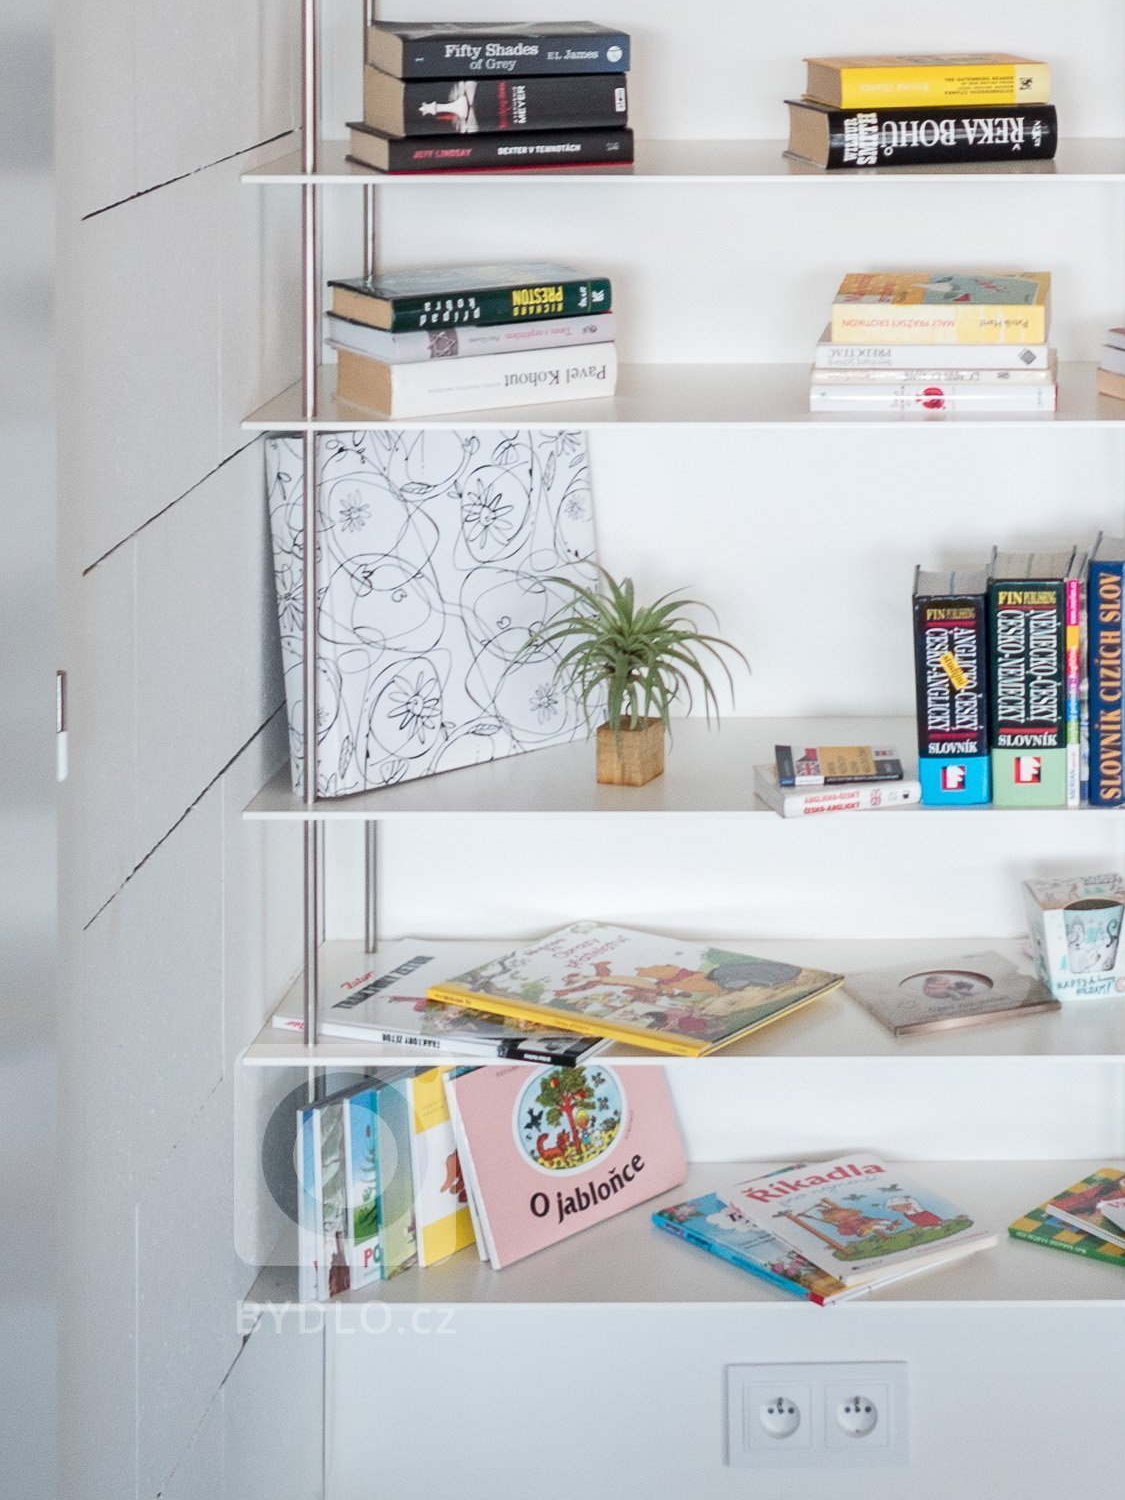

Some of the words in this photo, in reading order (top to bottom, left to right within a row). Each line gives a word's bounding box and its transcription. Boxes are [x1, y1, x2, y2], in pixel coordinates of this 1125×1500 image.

[444, 44, 483, 61] Fifty
[485, 42, 539, 58] Shades
[564, 49, 599, 61] James
[469, 58, 484, 71] of
[485, 58, 517, 71] Grey
[516, 85, 527, 124] MEYER
[843, 117, 859, 162] WILBUR
[856, 111, 879, 165] SMITH
[880, 117, 957, 157] BOHŮ
[961, 116, 1025, 151] ŘEKA
[423, 296, 476, 313] kobra
[511, 285, 564, 306] PRESTON
[512, 301, 563, 317] RICHARD
[503, 369, 562, 390] Kohout
[565, 364, 608, 386] Pavel
[998, 590, 1022, 605] FIN
[1098, 572, 1122, 623] SLOV
[925, 608, 945, 621] FIN
[1094, 629, 1122, 702] CIZÍCH
[928, 739, 978, 754] SLOVNÍK
[997, 732, 1057, 747] SLOVNÍK
[1093, 708, 1122, 800] SLOVNÍK
[528, 1191, 552, 1219] O
[556, 1152, 647, 1224] jabloňce
